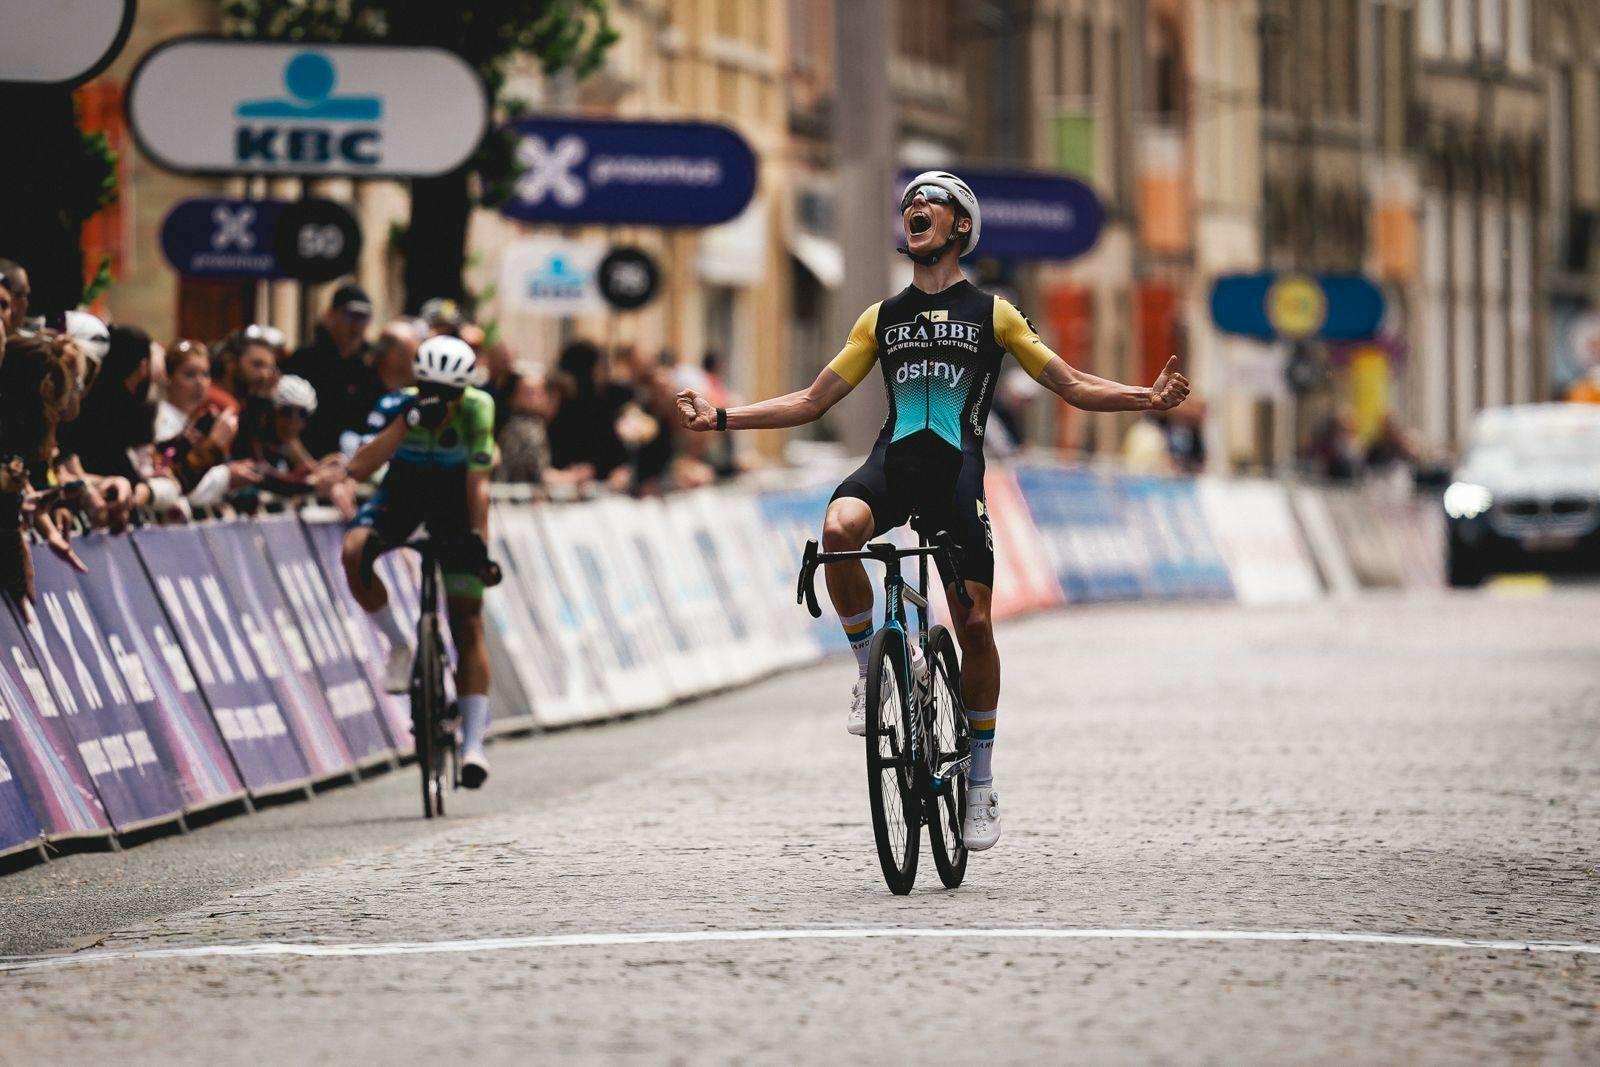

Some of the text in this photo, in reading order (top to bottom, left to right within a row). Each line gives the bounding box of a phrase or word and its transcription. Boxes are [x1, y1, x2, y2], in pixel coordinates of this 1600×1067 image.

[236, 127, 382, 164] KBC
[885, 323, 980, 345] CRABBE
[937, 340, 978, 353] TOITURES
